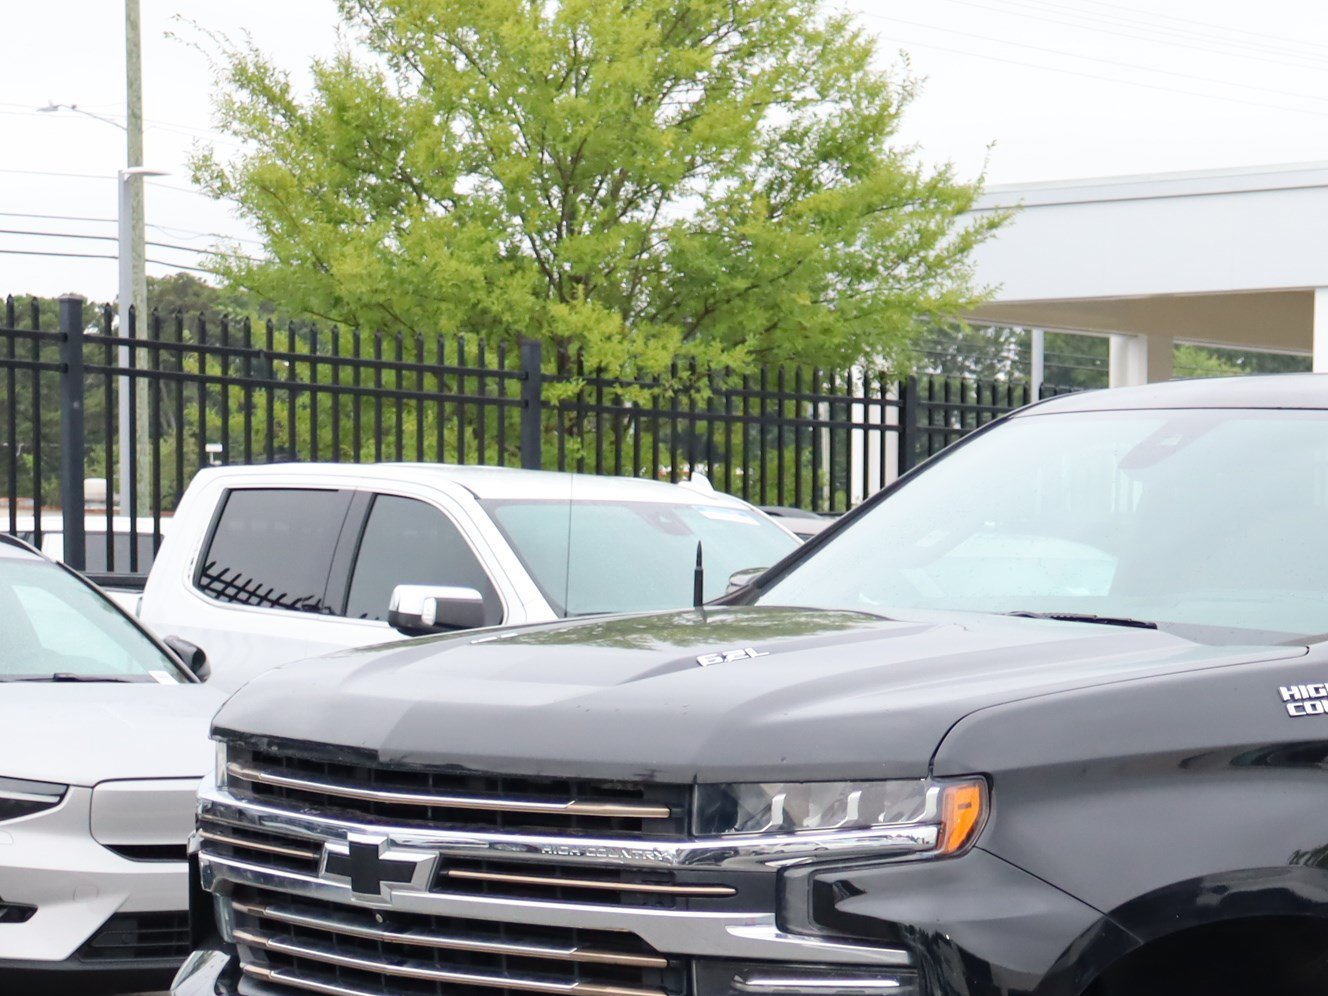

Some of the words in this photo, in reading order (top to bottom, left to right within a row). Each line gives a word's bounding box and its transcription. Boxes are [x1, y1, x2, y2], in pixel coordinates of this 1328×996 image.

[697, 647, 770, 667] 6.2L
[541, 846, 582, 856] HIGH
[586, 847, 667, 861] COUNTRY
